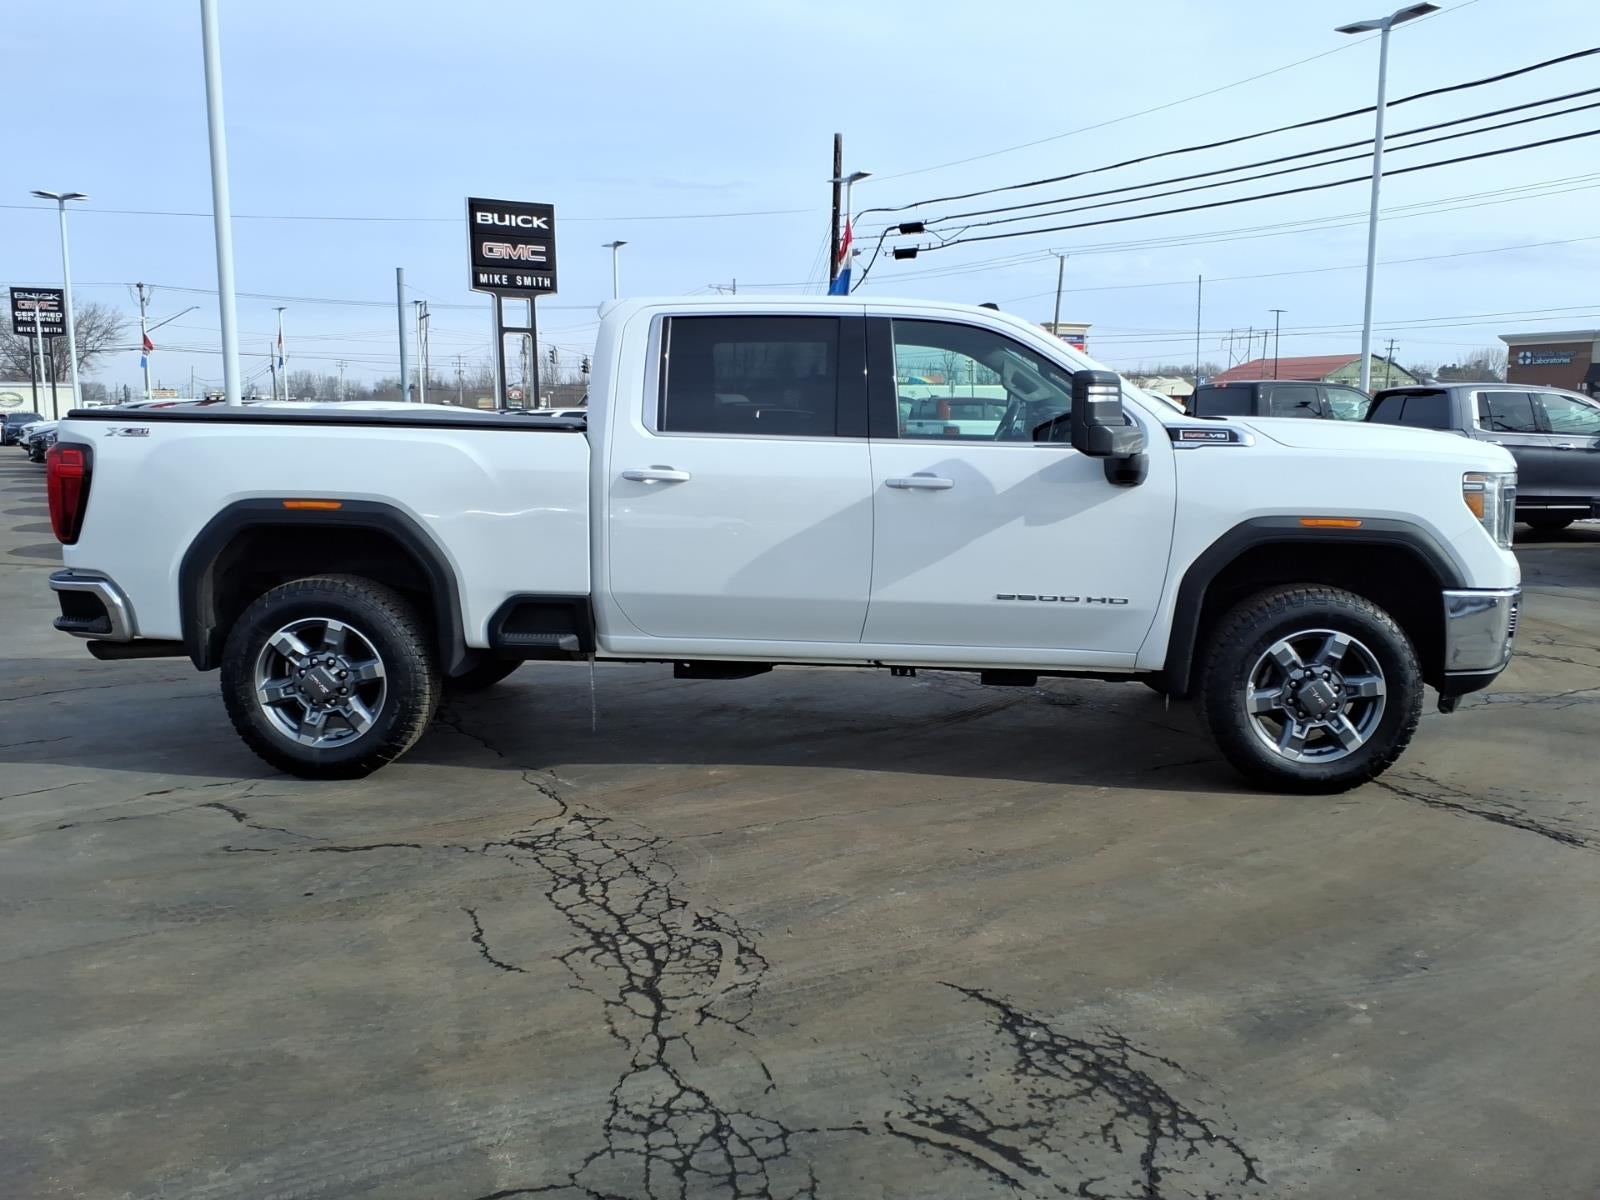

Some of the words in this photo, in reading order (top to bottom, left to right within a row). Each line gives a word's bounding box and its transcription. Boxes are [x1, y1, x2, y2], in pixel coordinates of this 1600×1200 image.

[476, 211, 549, 229] BUICK
[482, 241, 546, 262] GMC
[479, 273, 508, 284] MIKE
[516, 275, 551, 287] SMITH
[14, 292, 61, 300] BUICK
[1086, 597, 1129, 605] HD
